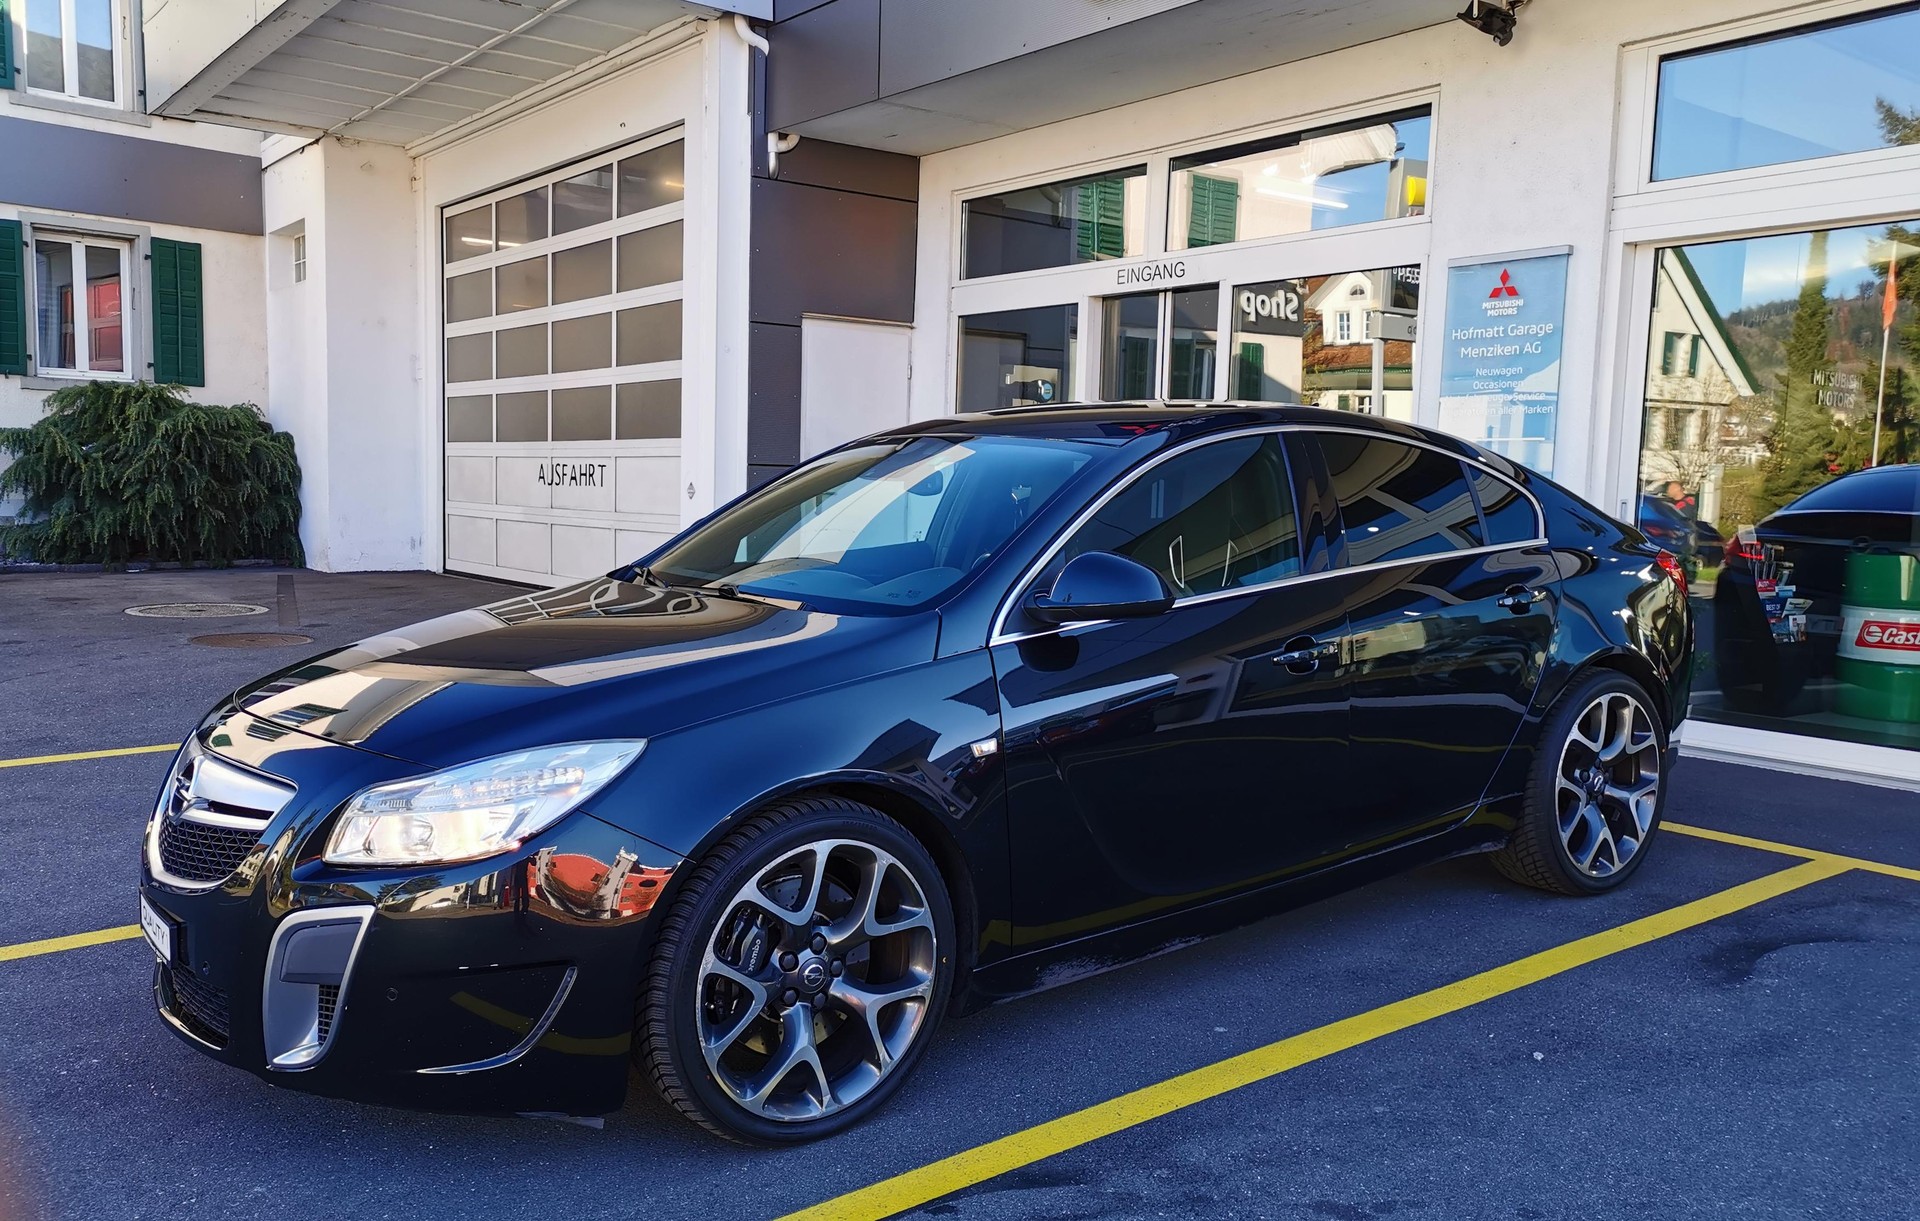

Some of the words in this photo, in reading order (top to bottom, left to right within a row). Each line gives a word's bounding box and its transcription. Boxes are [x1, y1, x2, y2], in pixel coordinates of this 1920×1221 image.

[1117, 261, 1186, 285] EINGANG
[1482, 299, 1524, 310] MITSUBISHI
[1487, 307, 1518, 317] MOTORS
[1452, 326, 1504, 341] Hofmatt
[1507, 323, 1554, 338] Garage
[1460, 343, 1520, 358] Menziken
[1522, 341, 1542, 355] AG
[1475, 366, 1523, 378] Neuwagen
[1472, 379, 1524, 390] Occasionen
[1818, 389, 1855, 409] MOTORS
[537, 463, 607, 488] AUSFAHRT
